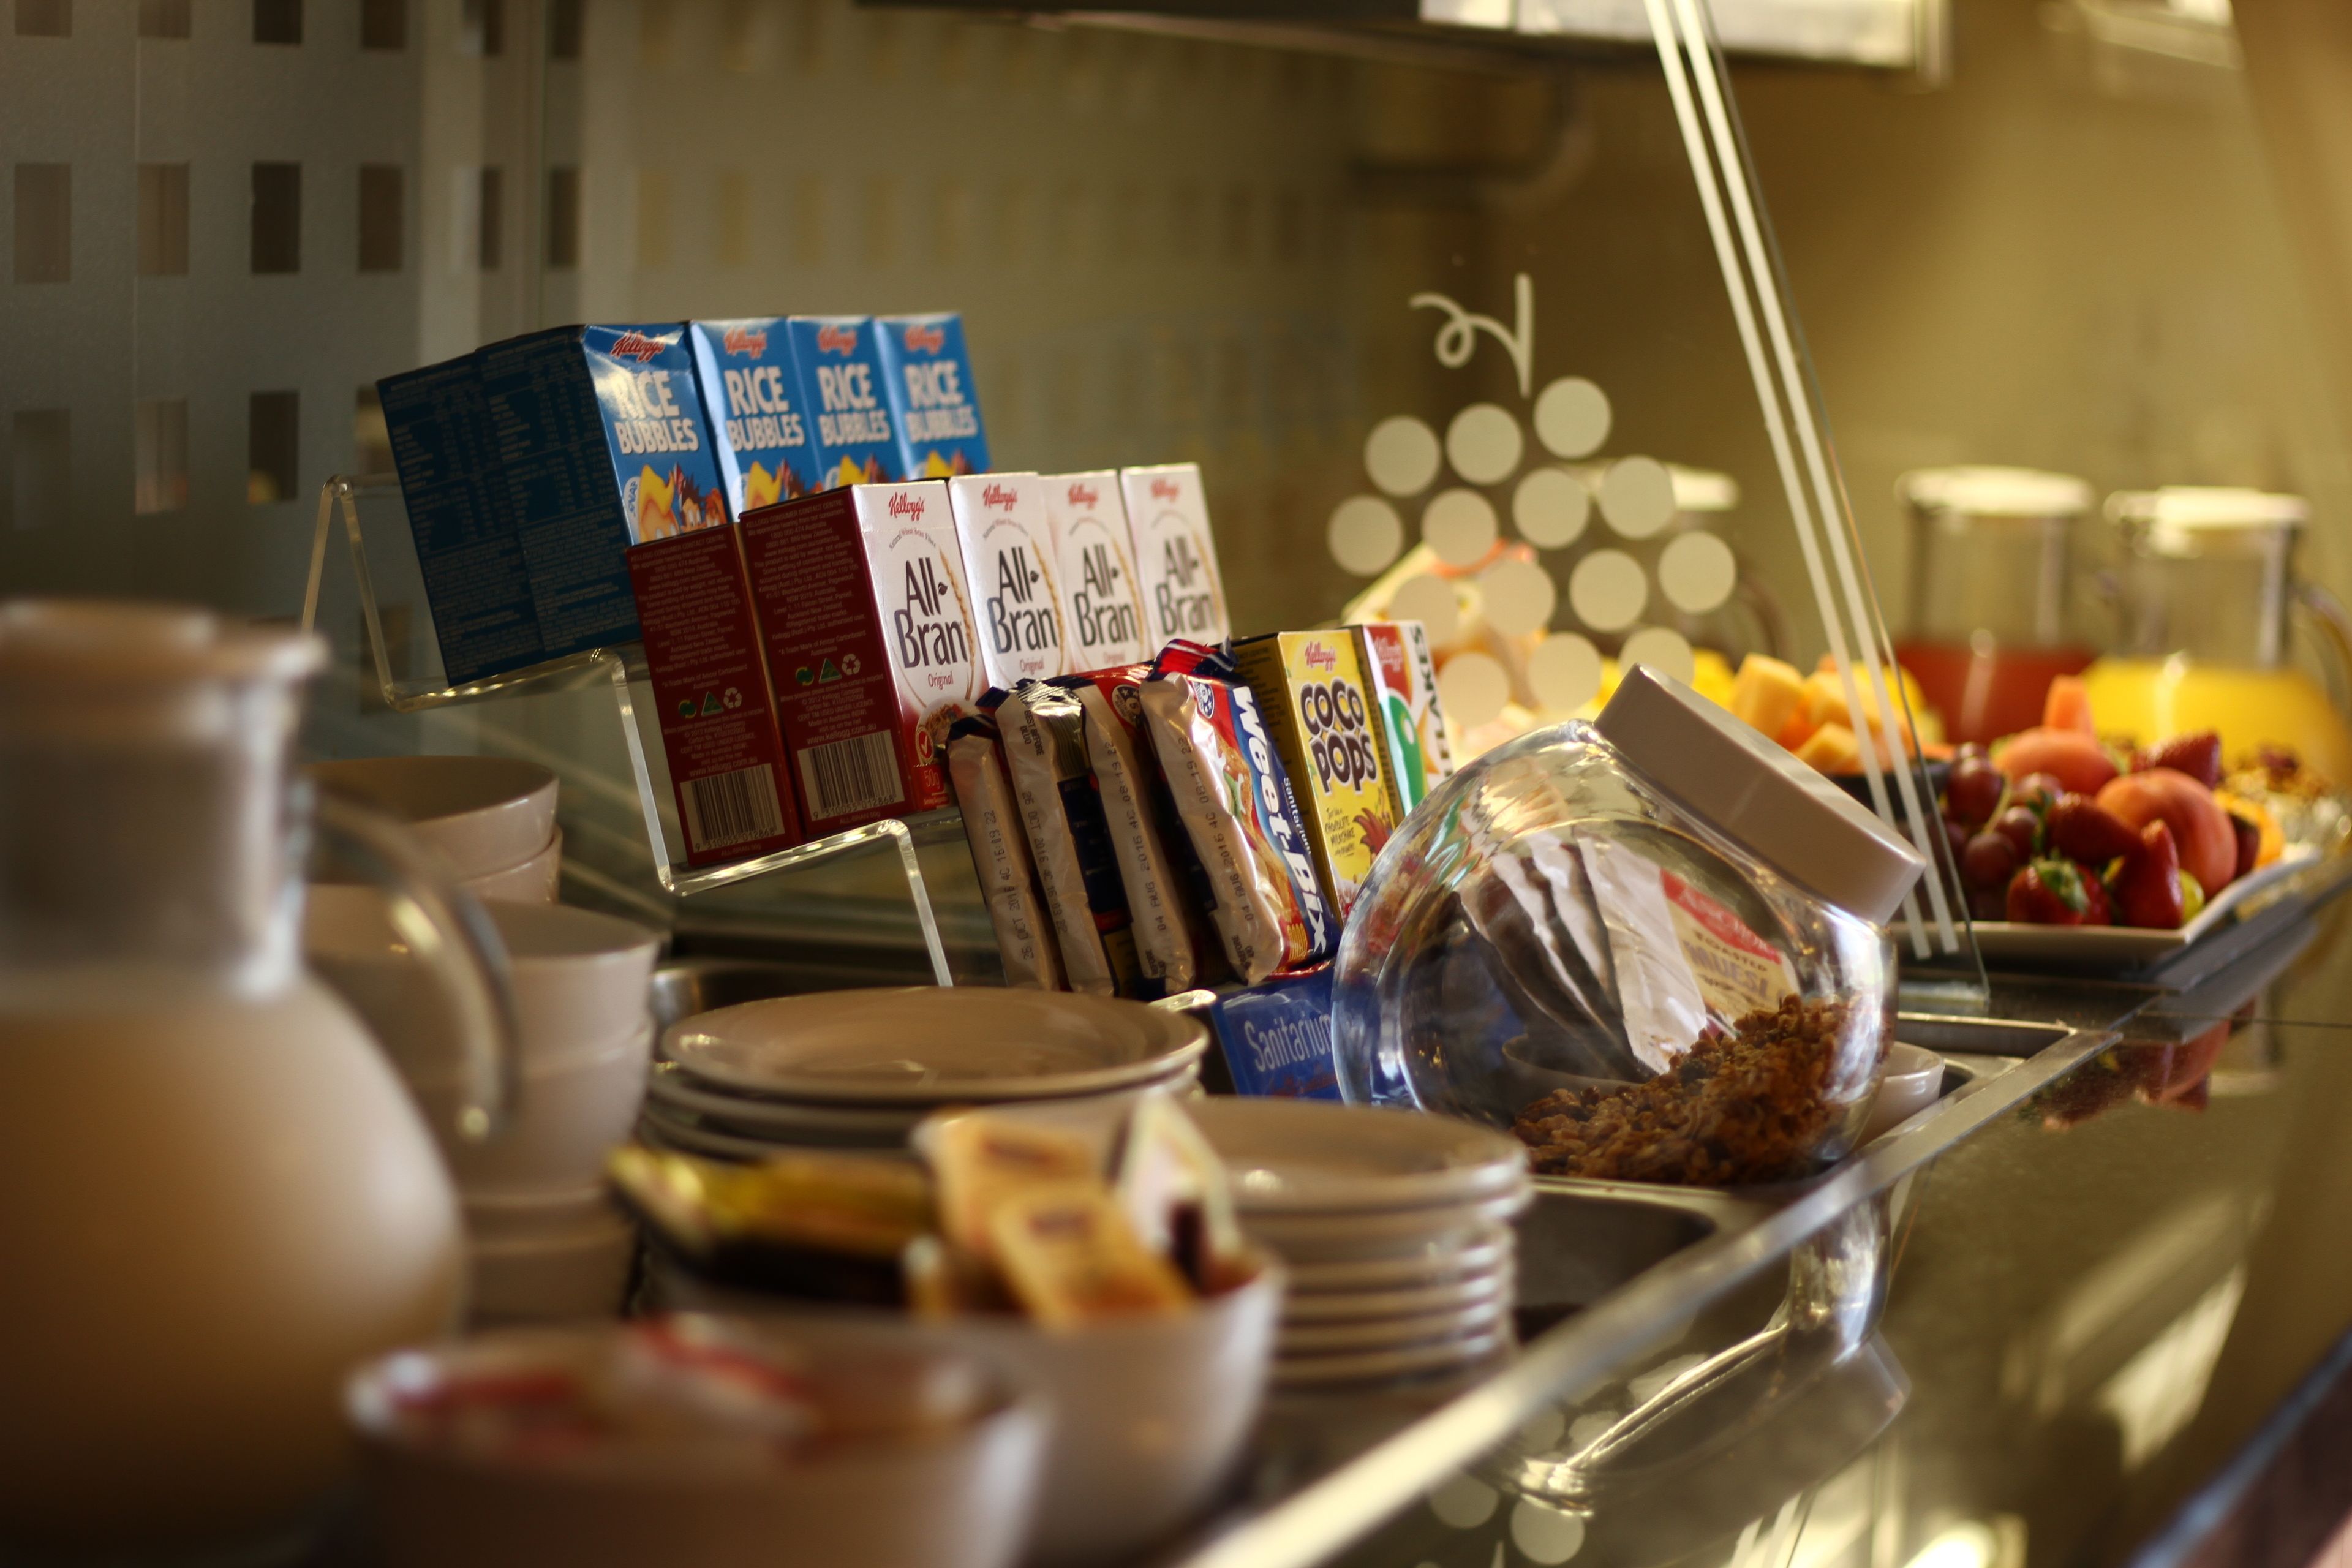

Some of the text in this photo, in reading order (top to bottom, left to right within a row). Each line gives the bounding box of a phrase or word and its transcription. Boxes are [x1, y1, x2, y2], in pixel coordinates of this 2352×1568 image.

[614, 369, 680, 420] RICE
[724, 366, 790, 417] RICE
[817, 363, 877, 412] RICE
[905, 360, 965, 408] RICE
[614, 418, 699, 454] BUBBLES
[727, 413, 805, 451] BUBBLES
[818, 409, 891, 447] BUBBLES
[905, 405, 978, 444] BUBBLES
[889, 492, 925, 521] Kellogg's
[987, 597, 1057, 654] Bran
[1074, 592, 1137, 647] Bran
[894, 610, 968, 669] Bran
[927, 671, 954, 690] Original
[1299, 677, 1365, 736] COCO
[924, 769, 940, 790] 50g
[1310, 731, 1378, 794] POPS
[1026, 810, 1041, 831] OCT
[1232, 685, 1326, 956] Weet-Bix
[695, 843, 700, 851] 9
[1144, 880, 1161, 908] AUG
[1228, 872, 1246, 898] AUG
[1011, 915, 1030, 941] OCT
